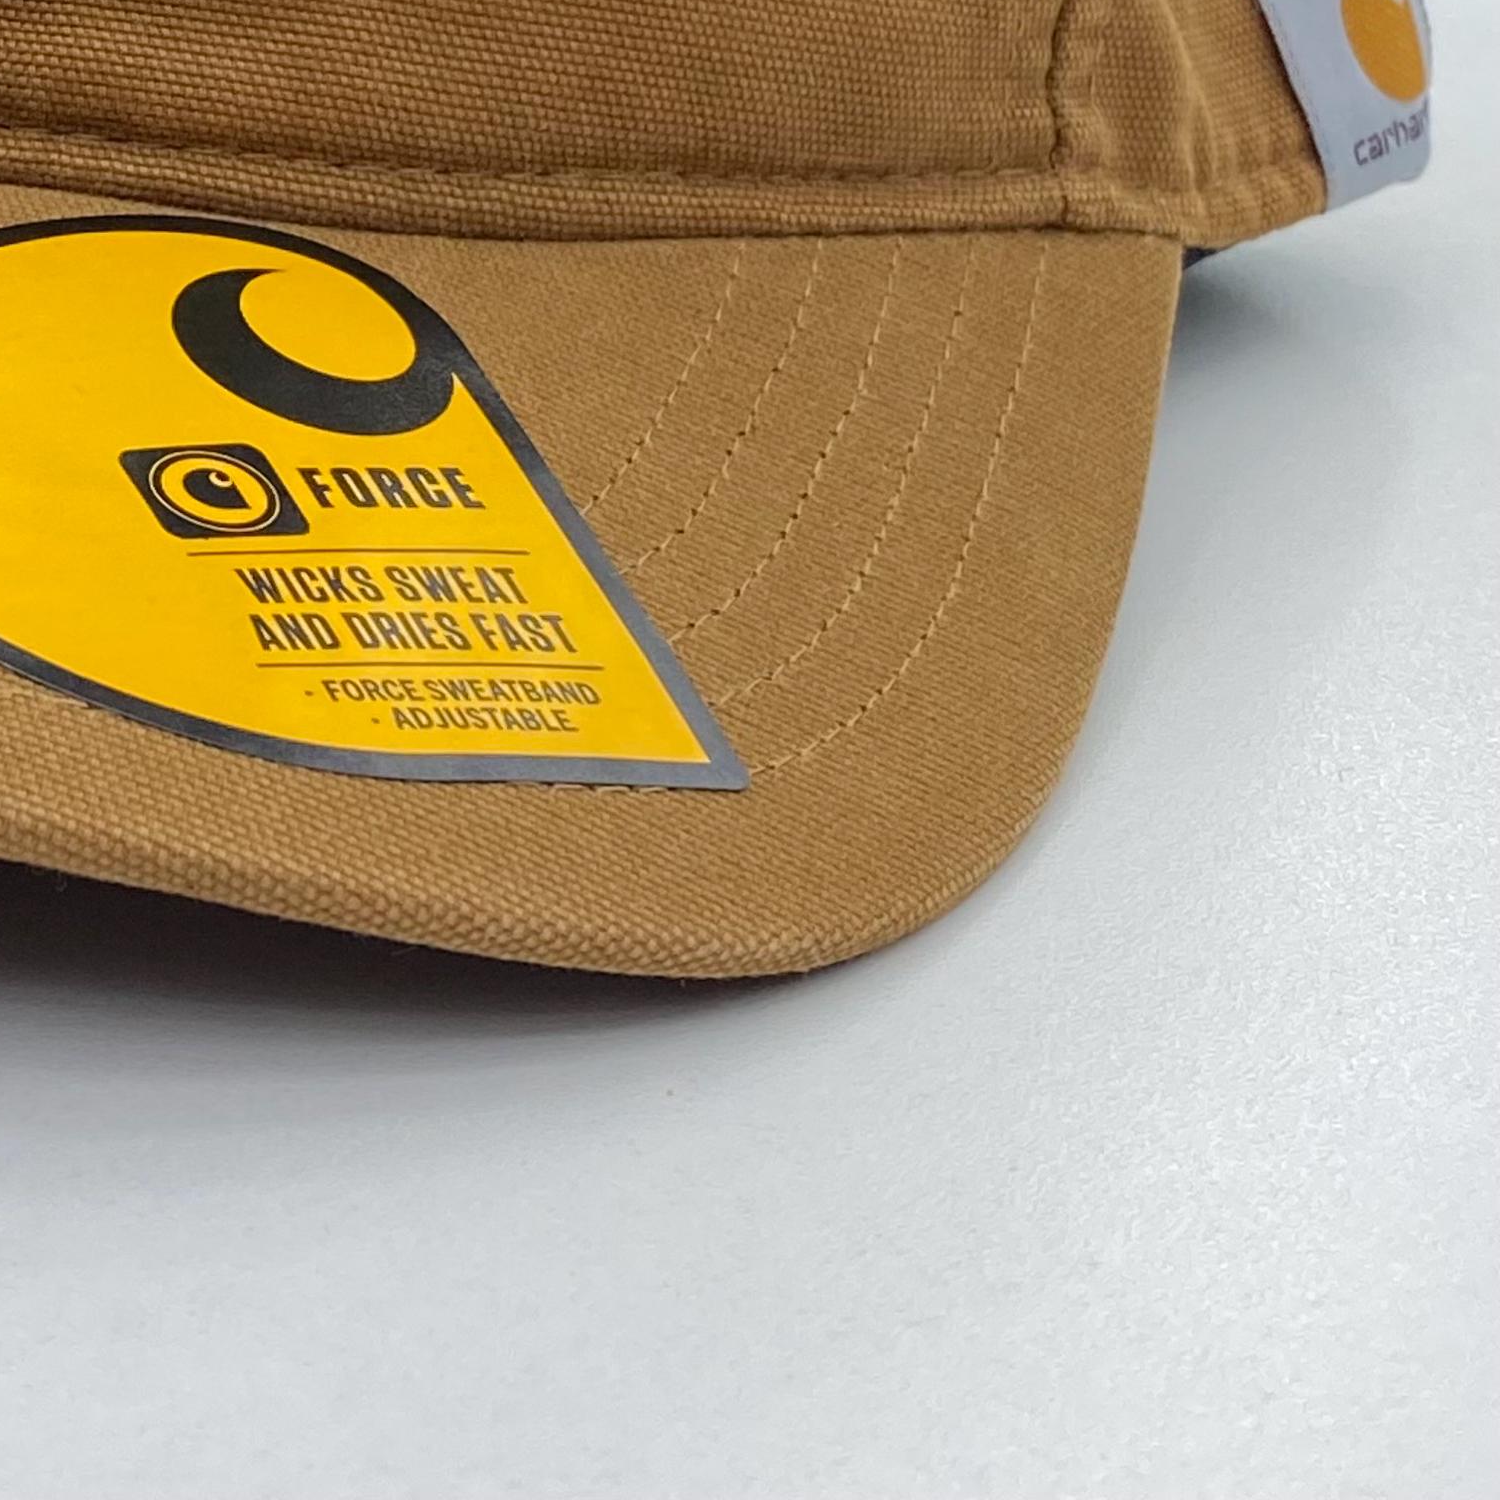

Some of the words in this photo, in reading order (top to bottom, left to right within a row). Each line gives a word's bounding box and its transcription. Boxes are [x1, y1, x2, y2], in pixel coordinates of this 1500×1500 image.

[296, 466, 486, 509] FORCE
[235, 565, 385, 604] WICKS
[384, 565, 528, 605] SWEAT
[249, 611, 342, 651] AND
[340, 611, 473, 651] DRIES
[468, 613, 578, 654] FAST
[321, 678, 424, 703] FORCE
[423, 678, 601, 706] SWEATBAND
[392, 706, 579, 732] ADJUSTABLE
